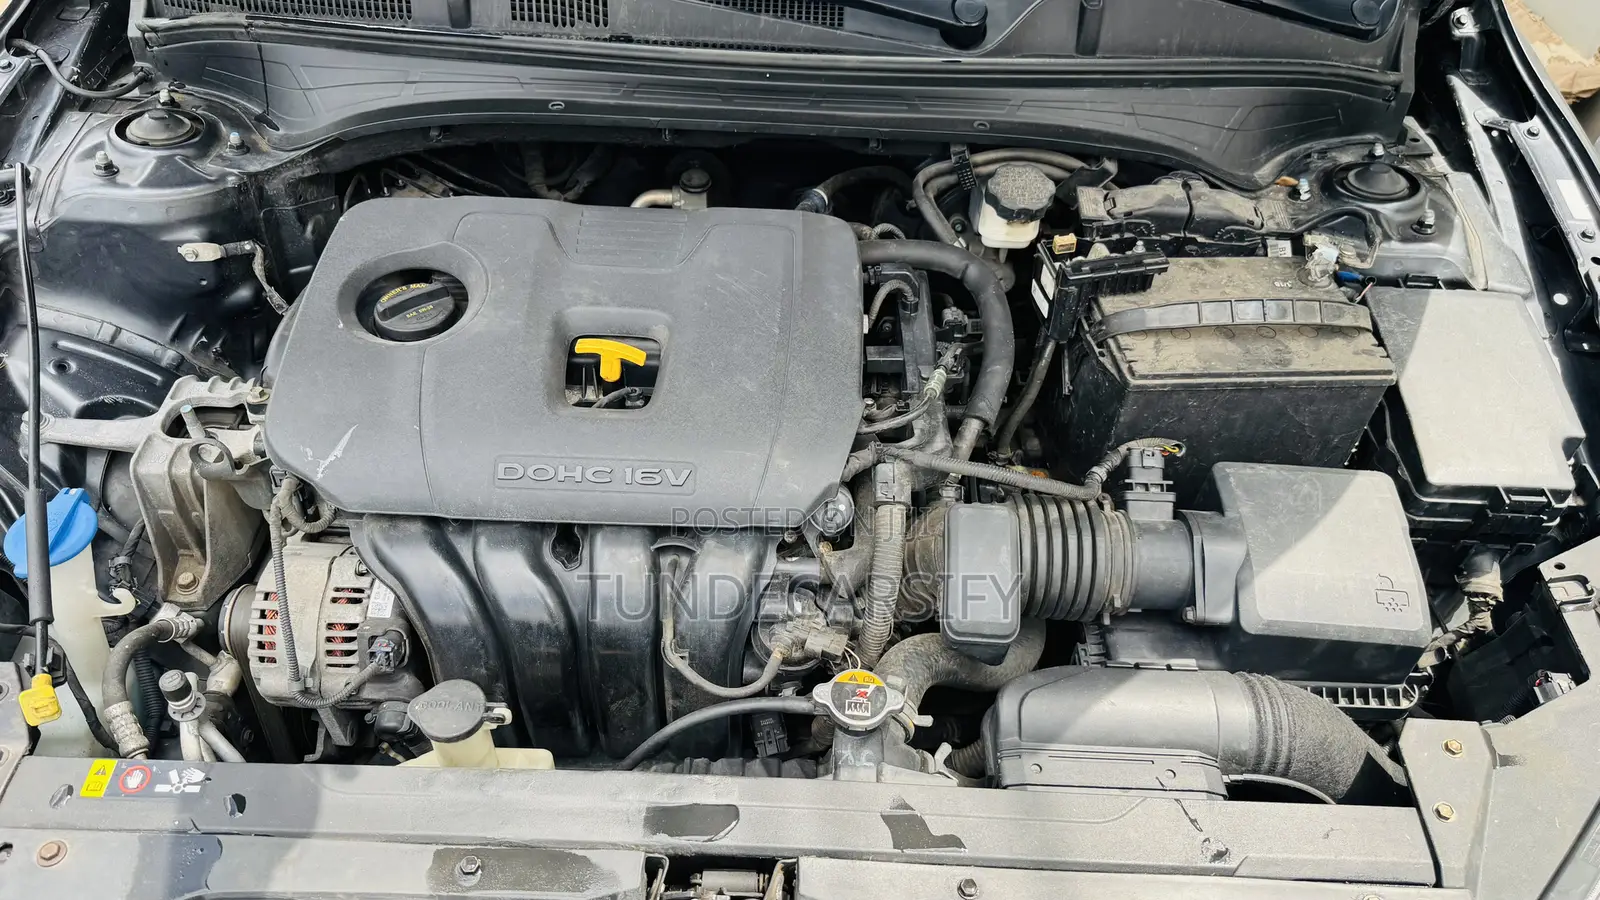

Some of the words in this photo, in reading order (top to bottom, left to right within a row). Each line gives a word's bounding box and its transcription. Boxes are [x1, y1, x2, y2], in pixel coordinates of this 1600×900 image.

[497, 462, 614, 484] DOHC
[624, 467, 692, 487] 16V
[418, 700, 481, 713] COOLANT
